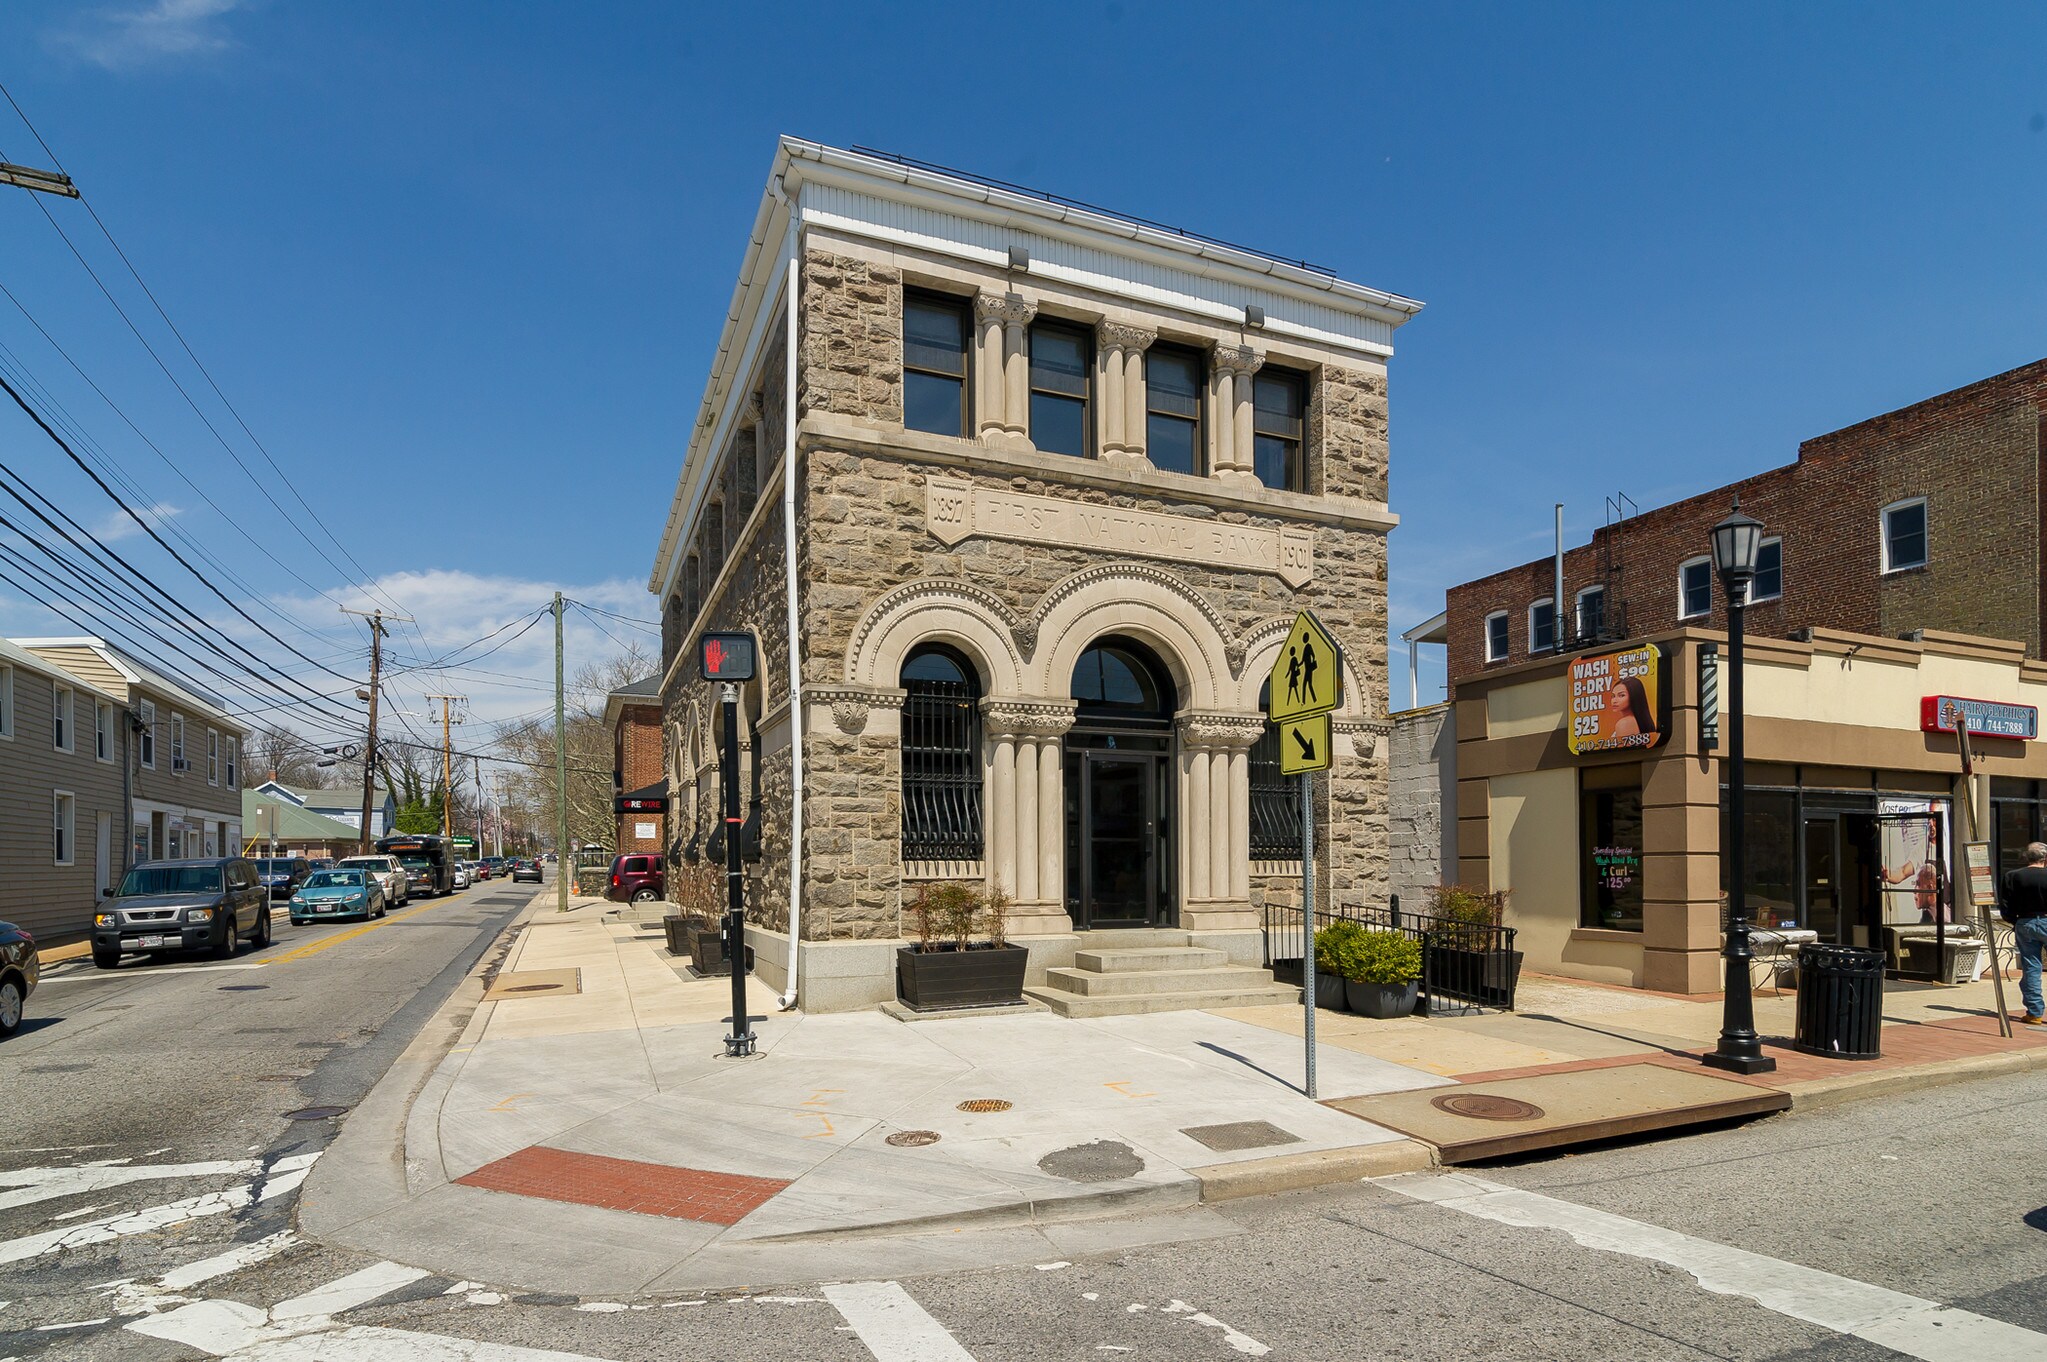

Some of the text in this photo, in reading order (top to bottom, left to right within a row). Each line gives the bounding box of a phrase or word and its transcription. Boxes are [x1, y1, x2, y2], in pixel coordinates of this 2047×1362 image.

[933, 497, 964, 523] 1897
[986, 500, 1268, 562] FIRST NATIONAL BANK
[1618, 651, 1649, 664] SEW-IN
[1573, 660, 1610, 680] WASH
[1618, 664, 1649, 679] $90
[1573, 676, 1612, 696] B-DRY
[1573, 695, 1605, 712] CURL
[1960, 702, 2027, 719] HAIROGLYPHICS
[1574, 715, 1600, 738] $25
[1988, 719, 2024, 734] 744-7888
[1575, 733, 1650, 751] 410-744-7888
